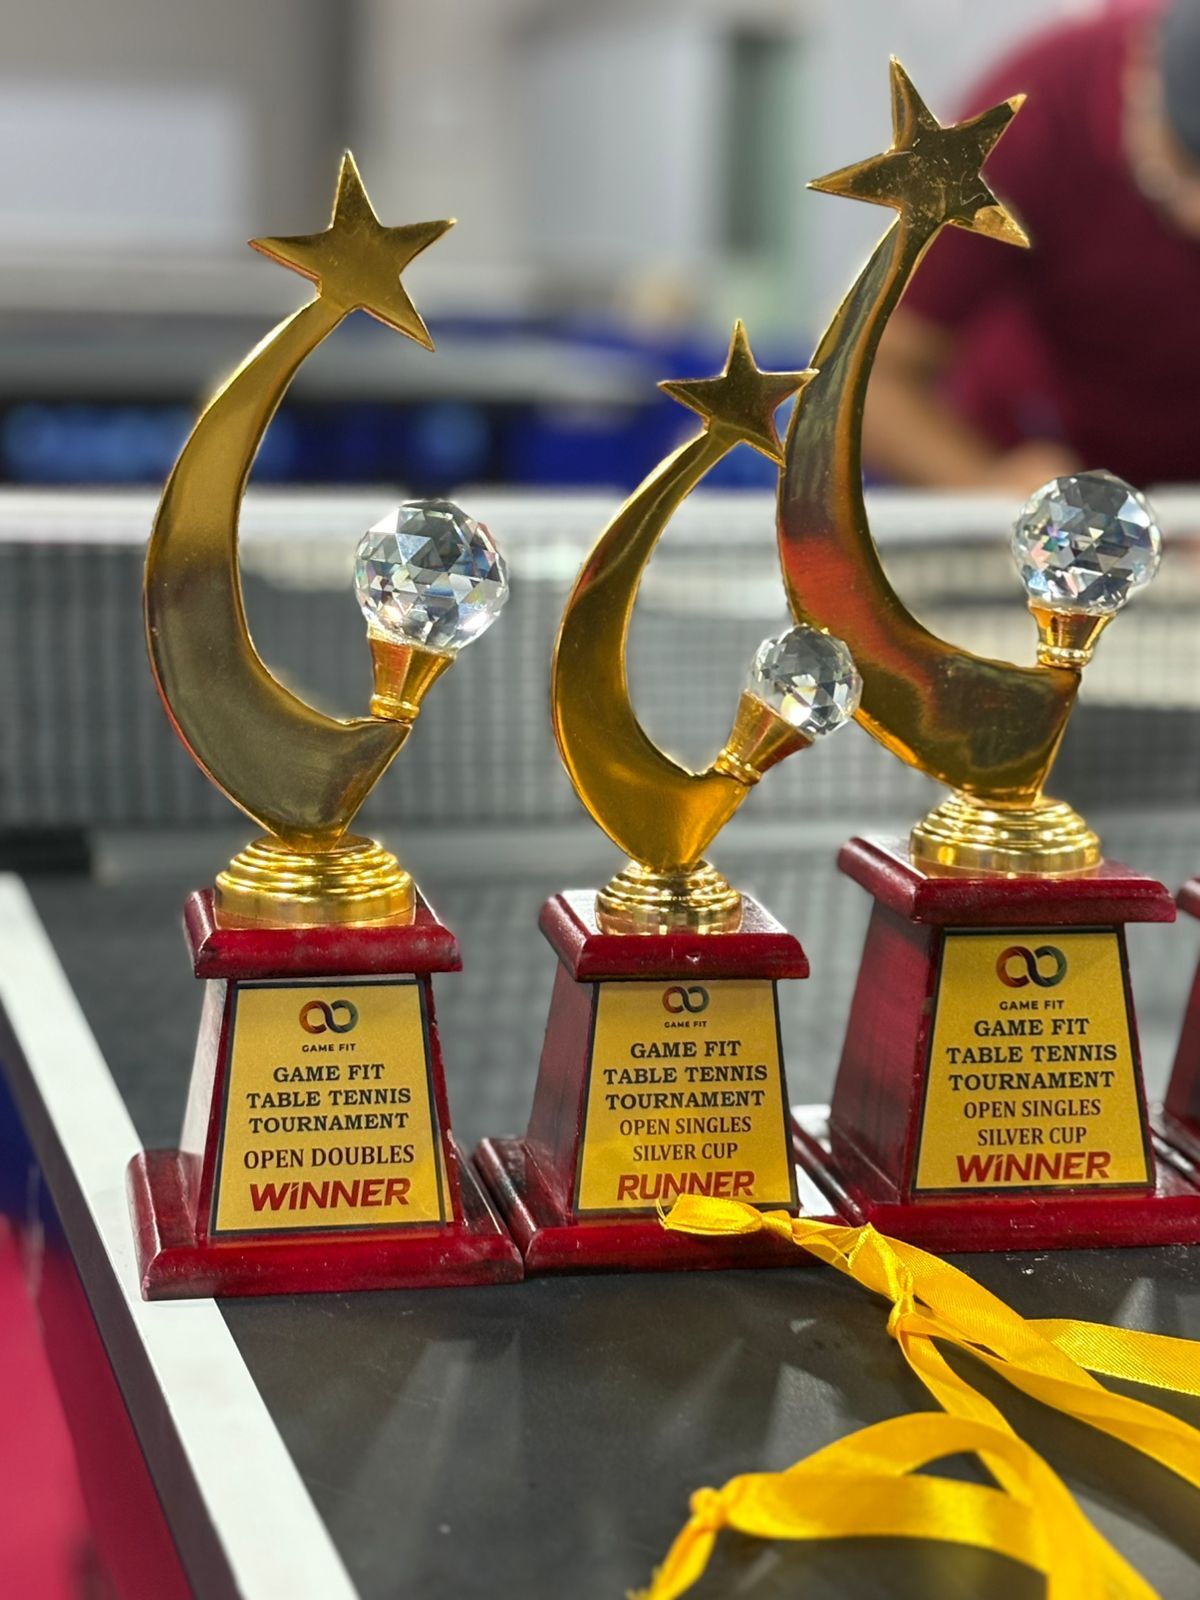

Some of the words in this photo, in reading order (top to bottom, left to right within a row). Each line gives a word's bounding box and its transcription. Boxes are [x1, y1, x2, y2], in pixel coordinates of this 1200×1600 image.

[1000, 1001, 1038, 1010] GAME
[1044, 1000, 1064, 1009] FIT
[974, 1020, 1043, 1036] GAME
[1052, 1018, 1089, 1035] FIT
[302, 1044, 334, 1052] GAME
[339, 1043, 356, 1051] FIT
[631, 1042, 697, 1058] GAME
[704, 1040, 741, 1056] FIT
[946, 1047, 1023, 1064] TABLE
[1031, 1045, 1117, 1062] TENNIS
[273, 1066, 340, 1082] GAME
[348, 1064, 385, 1080] FIT
[603, 1067, 677, 1084] TABLE
[685, 1065, 767, 1082] TENNIS
[948, 1071, 1115, 1091] TOURNAMENT
[246, 1091, 320, 1109] TABLE
[328, 1088, 411, 1106] TENNIS
[605, 1091, 765, 1110] TOURNAMENT
[964, 1101, 1016, 1119] OPEN
[1022, 1099, 1101, 1116] SINGLES
[249, 1113, 409, 1133] TOURNAMENT
[620, 1119, 670, 1135] OPEN
[675, 1116, 751, 1134] SINGLES
[977, 1129, 1044, 1146] SILVER
[1050, 1127, 1087, 1144] CUP
[244, 1149, 304, 1169] OPEN
[311, 1145, 415, 1167] DOUBLES
[633, 1145, 696, 1161] SILVER
[701, 1143, 738, 1159] CUP
[617, 1171, 755, 1200] RUNNER
